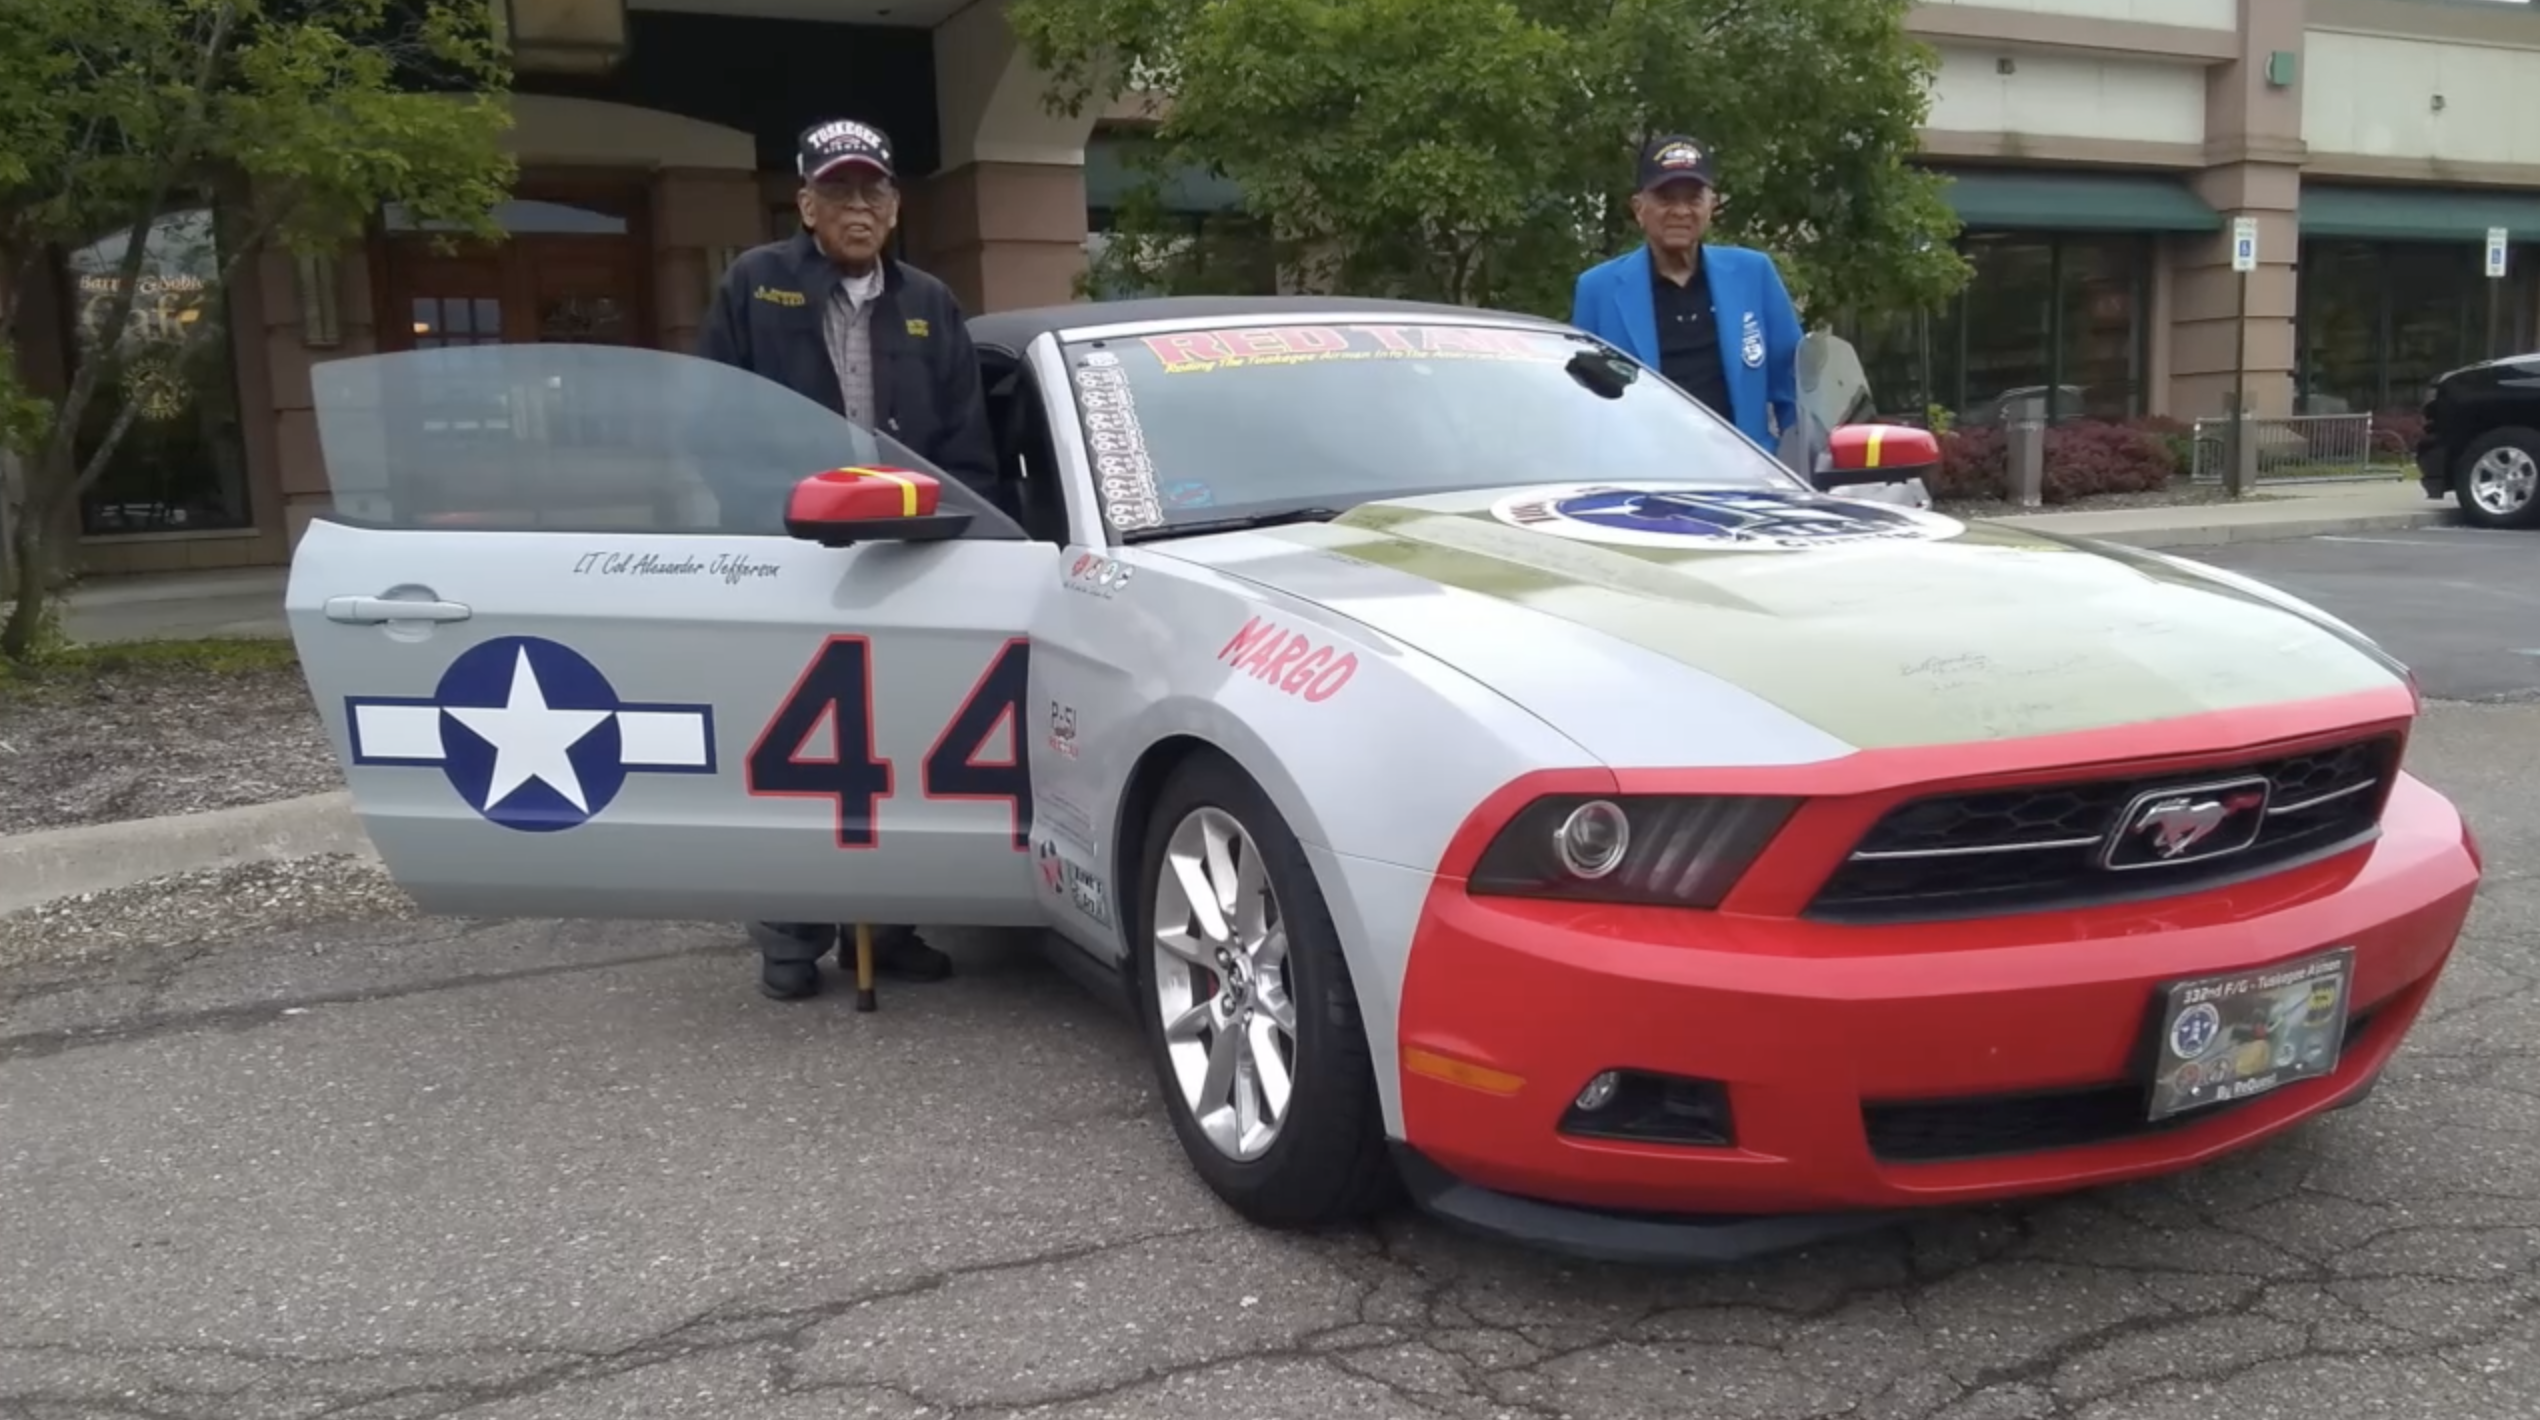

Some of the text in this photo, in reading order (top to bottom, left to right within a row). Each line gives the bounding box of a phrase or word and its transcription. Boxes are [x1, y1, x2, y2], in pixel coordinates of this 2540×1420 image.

[807, 120, 882, 149] TUSKEGEE
[1141, 325, 1349, 364] RED
[1217, 356, 1244, 368] The
[1249, 352, 1315, 367] Tuskegee
[1111, 503, 1137, 525] 66
[573, 551, 781, 585] LT Col Alexander Jefferson
[1217, 615, 1359, 703] MARGO
[2183, 983, 2223, 1005] 332nd
[2224, 979, 2249, 997] F/G
[2257, 968, 2306, 990] Tuskegee
[2306, 959, 2341, 979] Airmen
